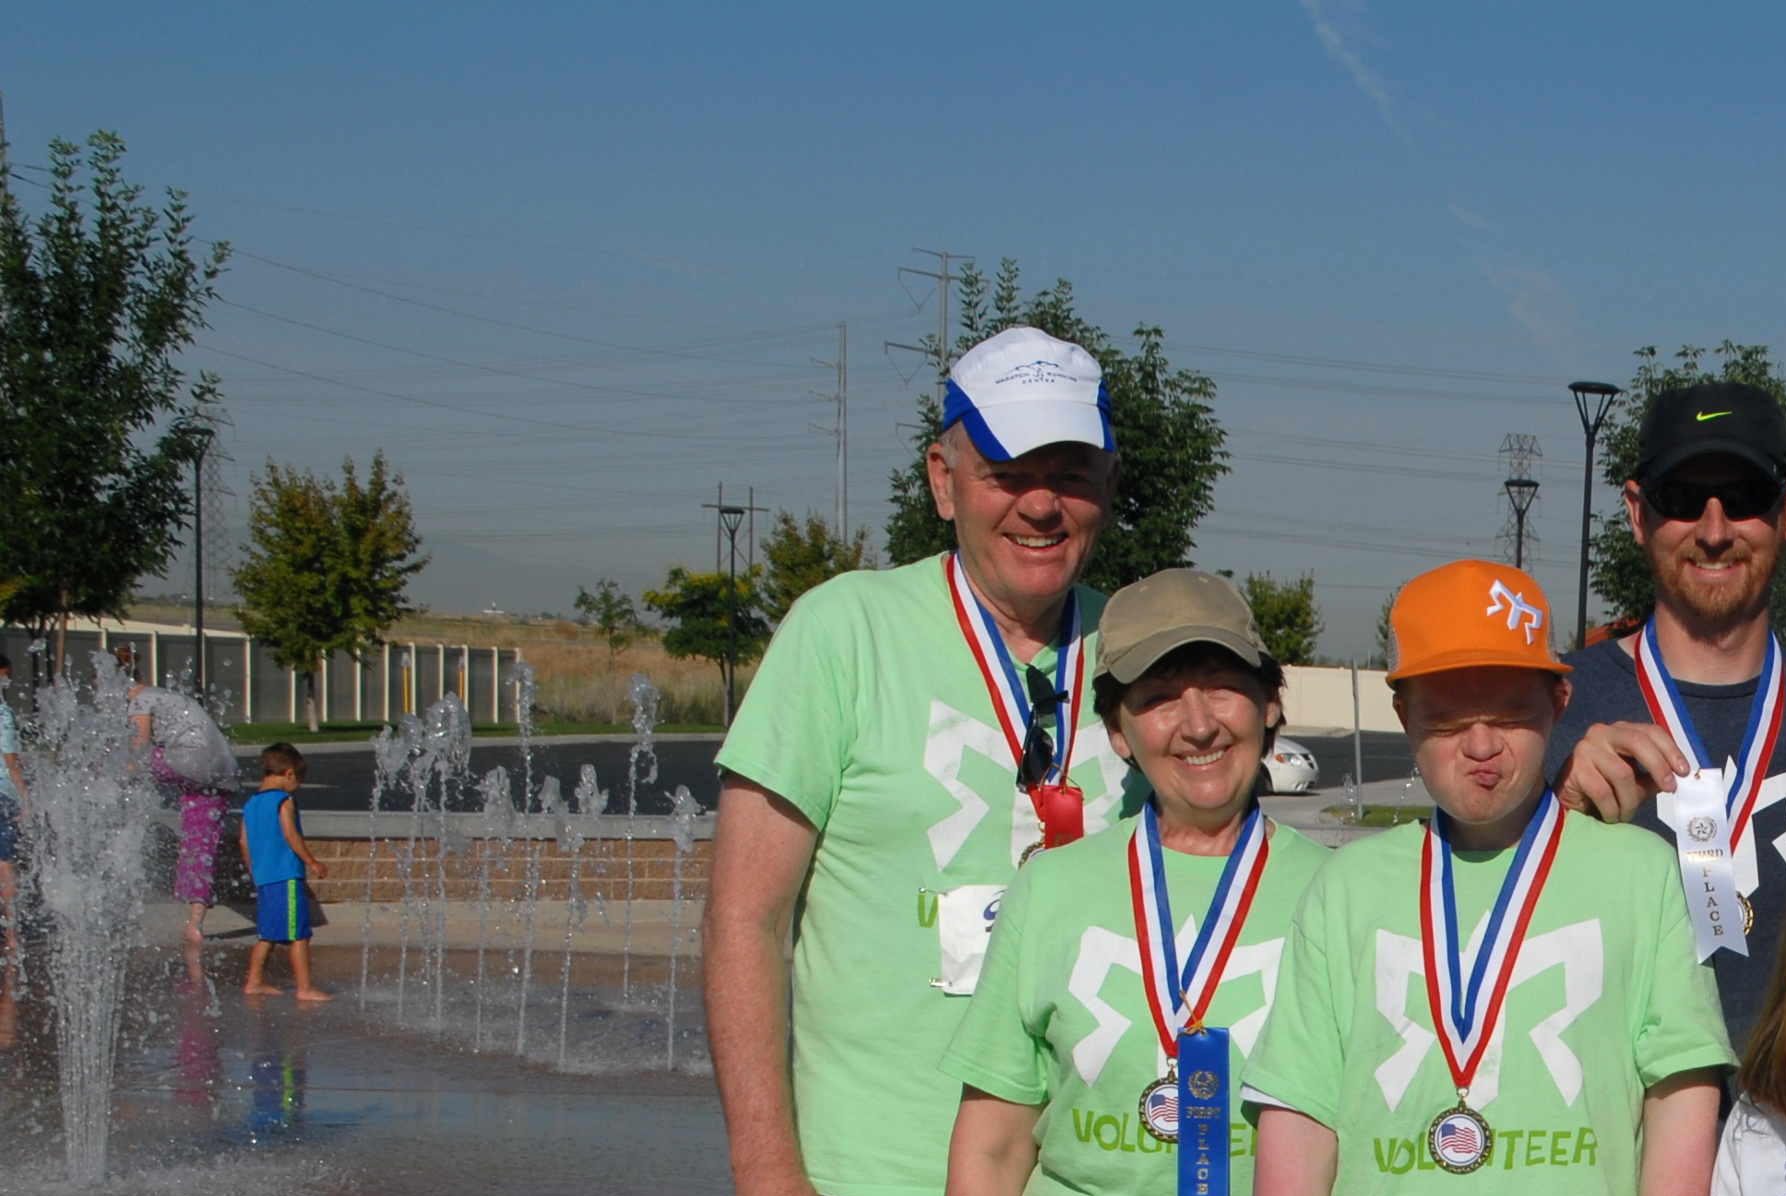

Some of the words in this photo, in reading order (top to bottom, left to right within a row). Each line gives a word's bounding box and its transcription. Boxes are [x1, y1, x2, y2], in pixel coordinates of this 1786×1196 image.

[1702, 867, 1724, 936] PLACE
[1186, 1106, 1221, 1119] FIRST
[1196, 1123, 1210, 1195] PLACE
